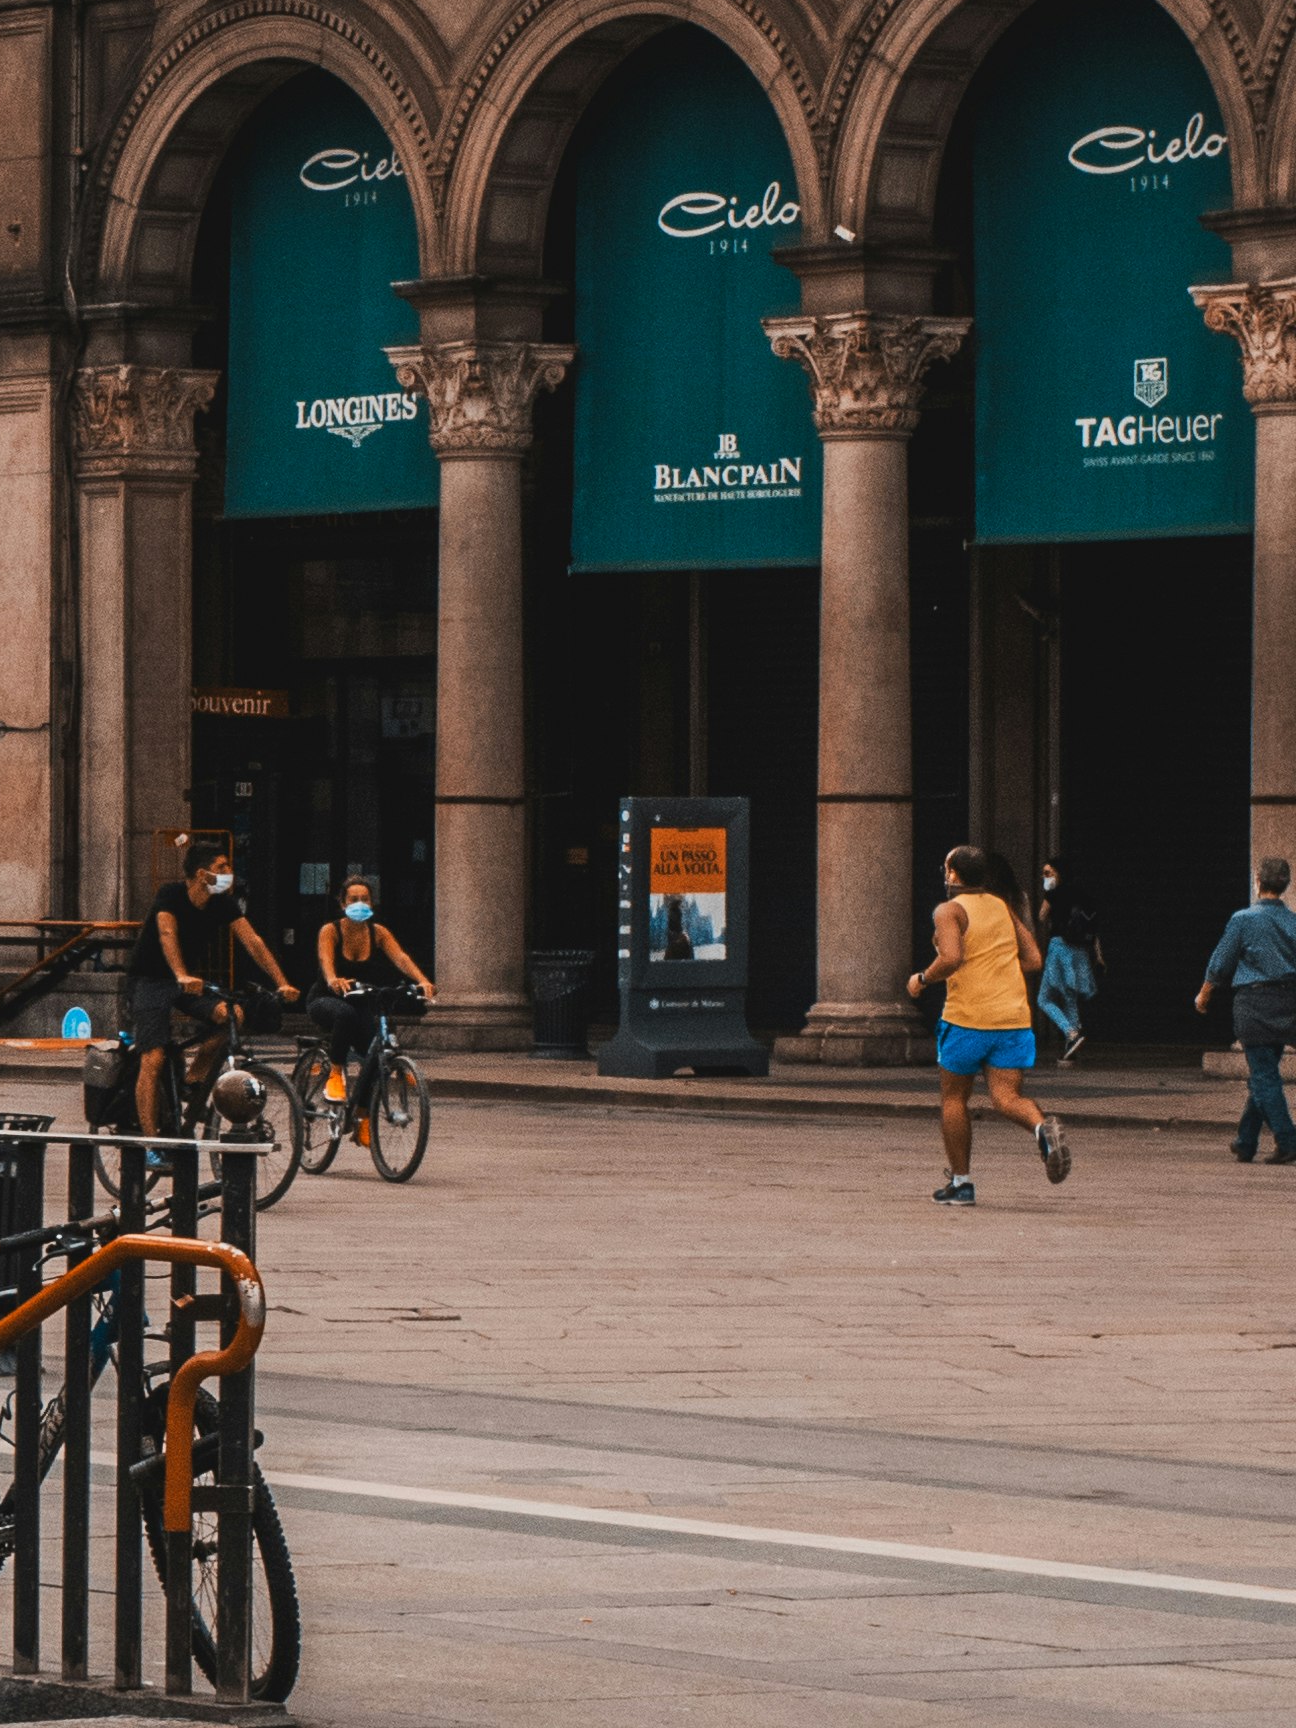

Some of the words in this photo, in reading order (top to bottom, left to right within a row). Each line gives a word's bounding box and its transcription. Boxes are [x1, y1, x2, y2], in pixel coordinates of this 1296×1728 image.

[1068, 112, 1228, 174] Cielo
[1130, 174, 1169, 192] 1914
[344, 191, 377, 208] 1914
[658, 181, 801, 238] Cielo
[709, 239, 748, 255] 1914
[295, 392, 418, 429] LONGINES
[653, 457, 802, 490] BLANCPAIN
[660, 849, 678, 862] UN
[681, 849, 717, 862] PASSO
[654, 862, 680, 875] ALLA
